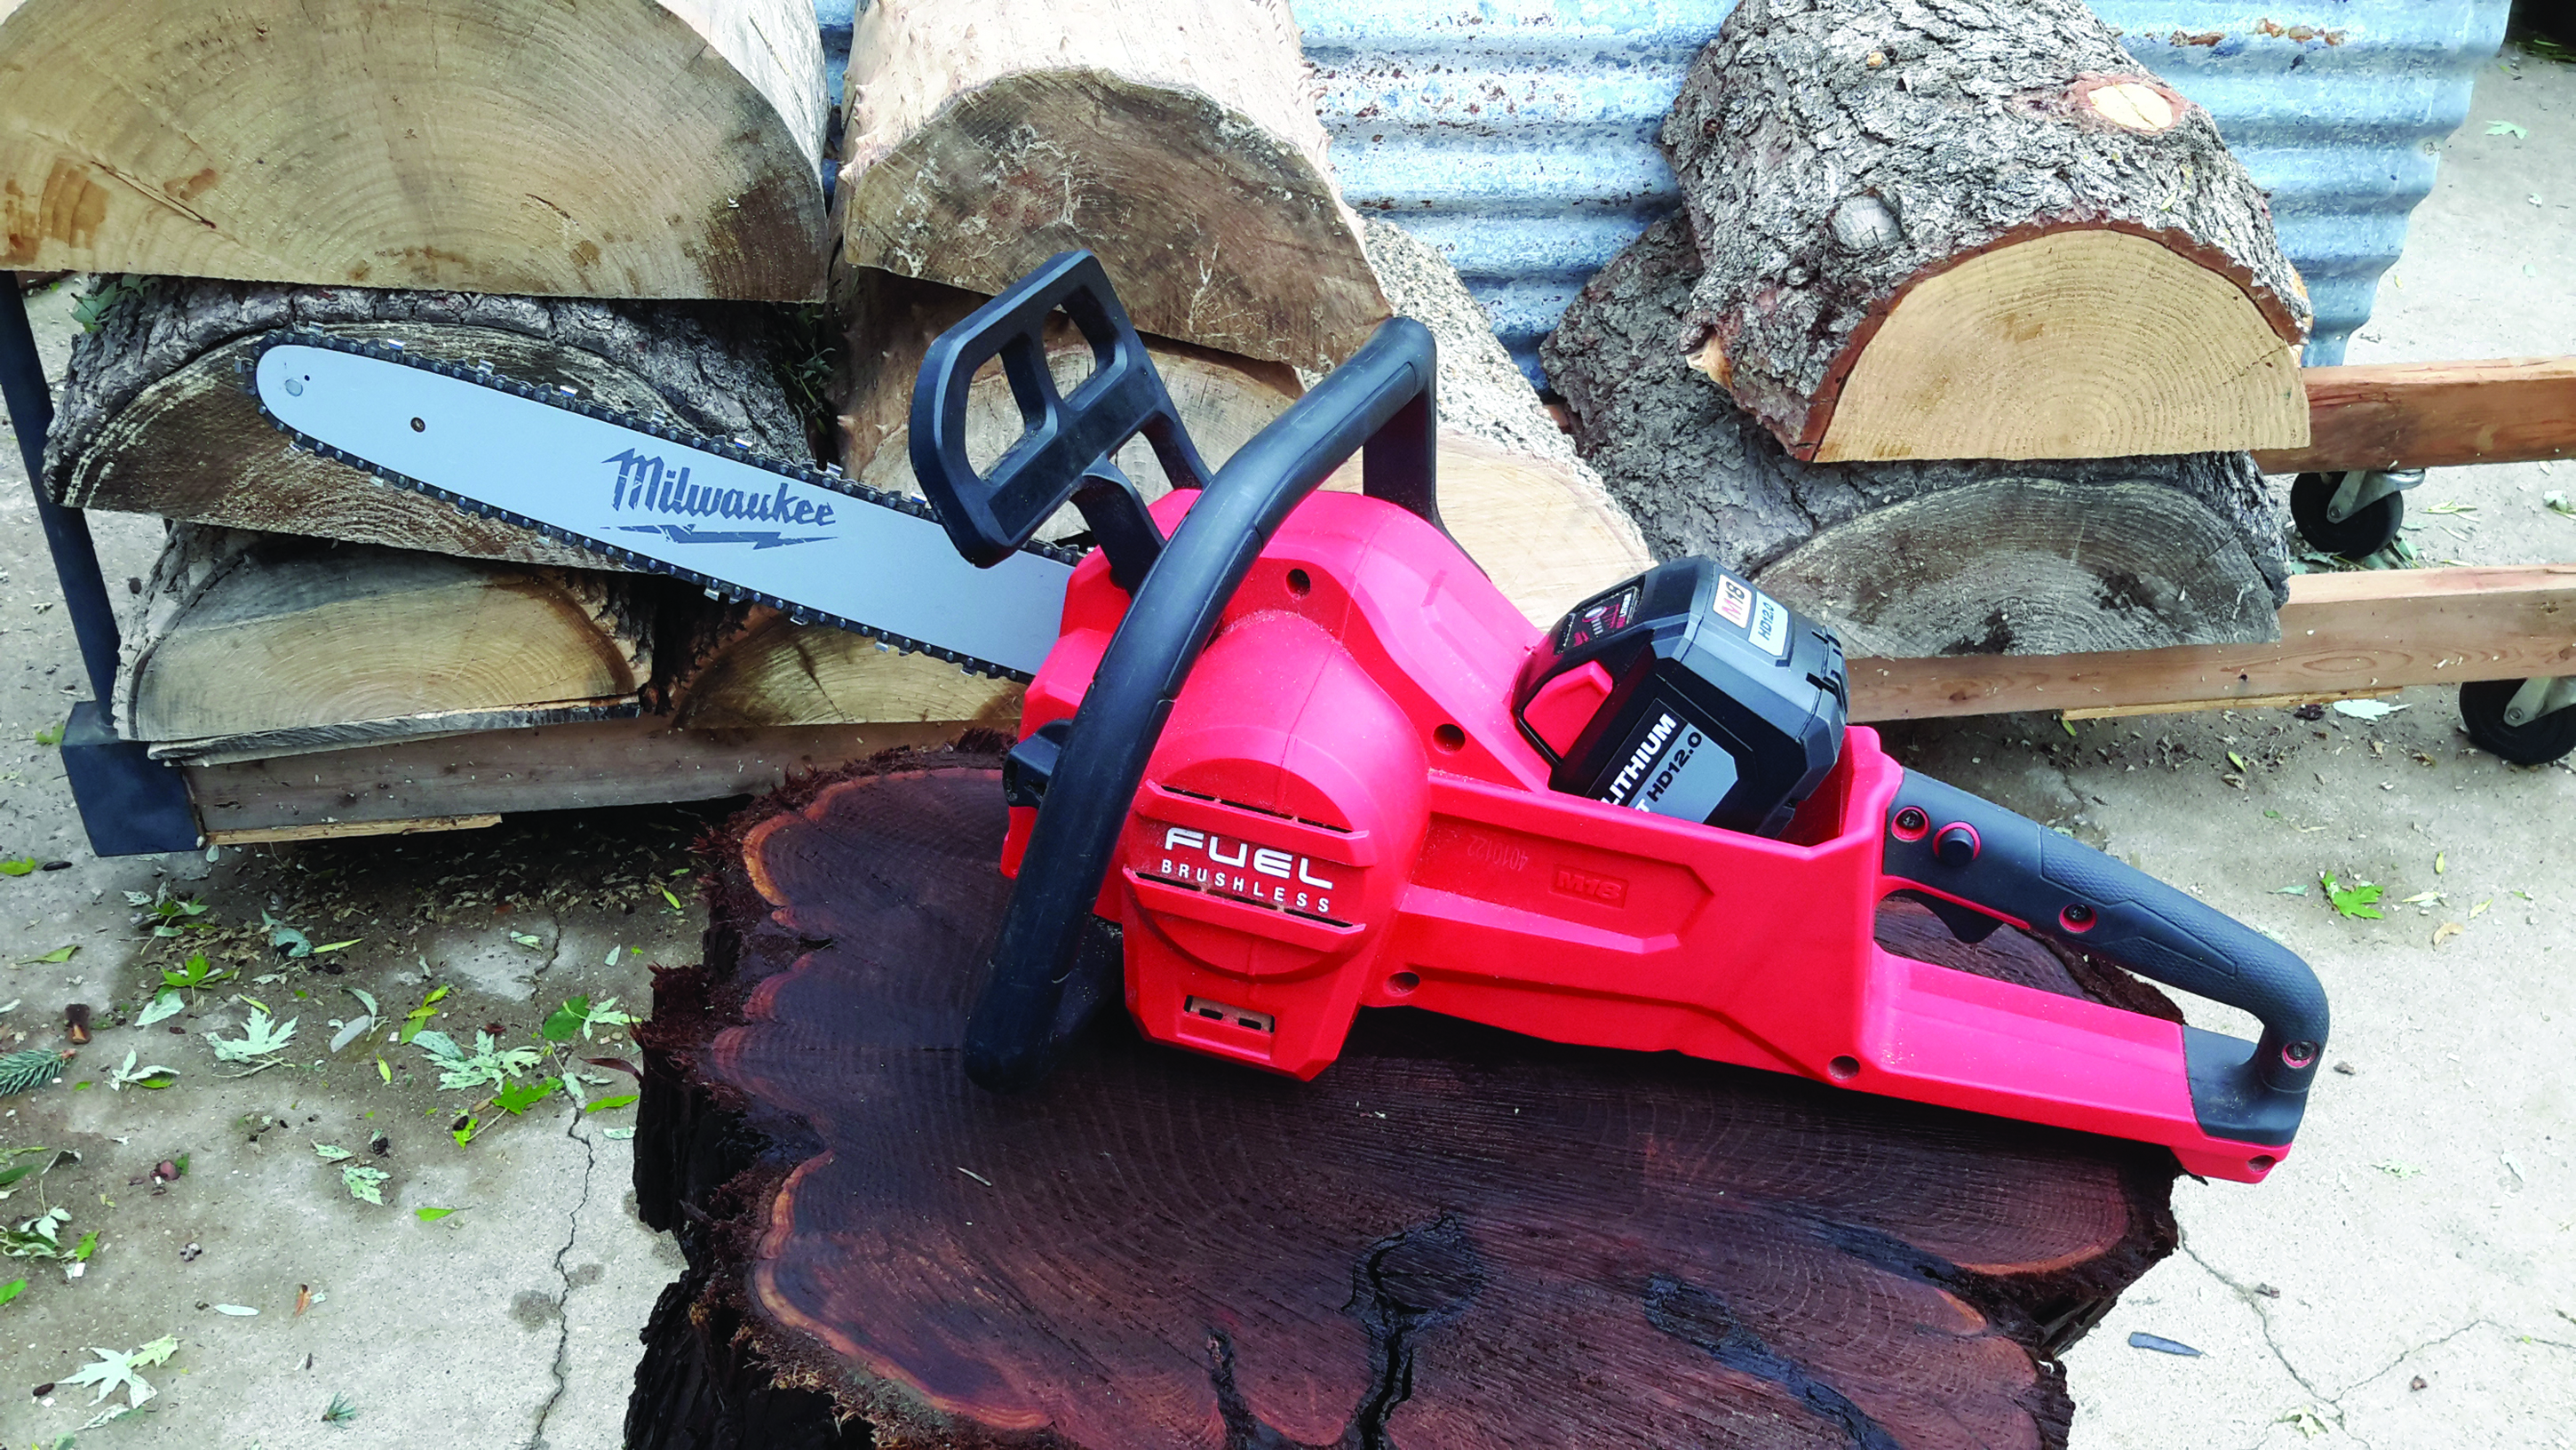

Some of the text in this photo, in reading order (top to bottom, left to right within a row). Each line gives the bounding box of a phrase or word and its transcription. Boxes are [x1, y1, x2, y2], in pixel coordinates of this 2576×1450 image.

[600, 448, 836, 527] Milwaukee
[1721, 581, 1745, 620] M18
[1758, 602, 1774, 641] HD12.0
[1646, 732, 1702, 802] HD12.0
[1161, 858, 1330, 912] BRUSHLESS
[1165, 827, 1333, 889] FUEL
[1555, 871, 1622, 899] M18
